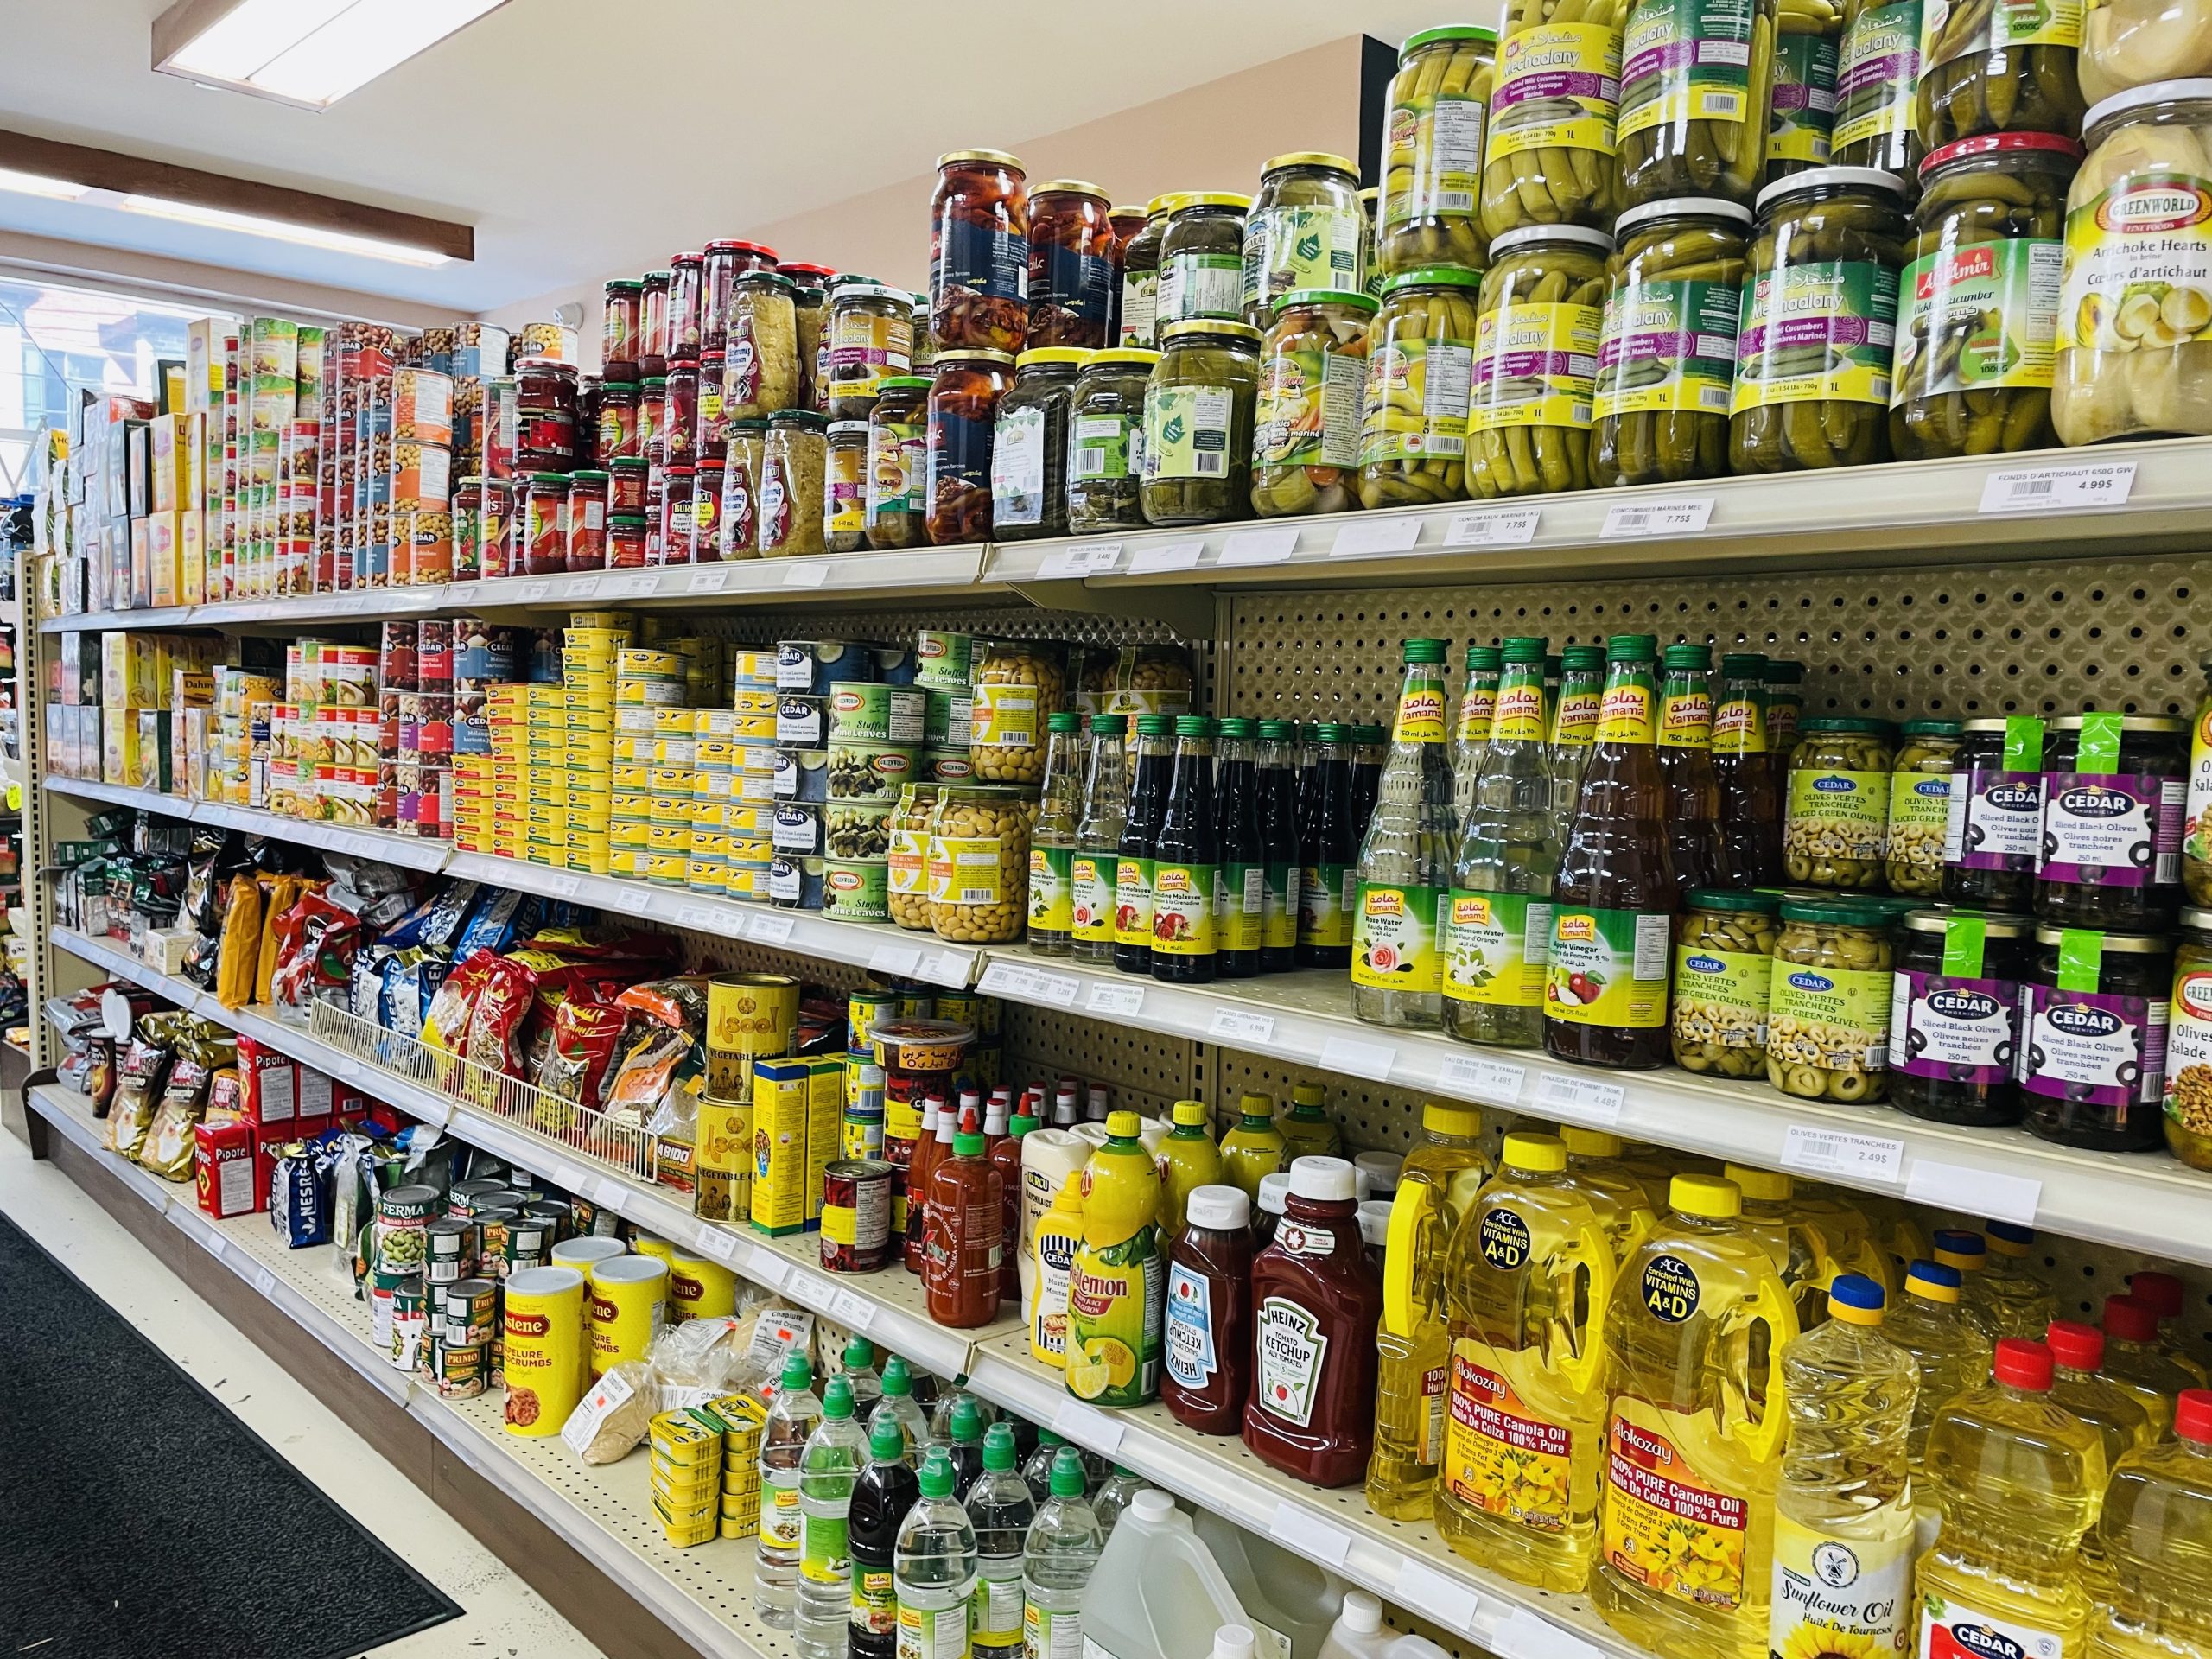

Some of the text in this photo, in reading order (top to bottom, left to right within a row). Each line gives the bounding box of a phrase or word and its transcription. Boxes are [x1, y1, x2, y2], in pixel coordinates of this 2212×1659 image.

[1503, 50, 1580, 78] Mechaalany
[1567, 130, 1574, 139] 1L
[2113, 198, 2196, 213] GREENWORLD
[2161, 240, 2207, 251] Hearts
[2129, 267, 2208, 279] d'artichaut
[1758, 283, 1770, 296] BM
[1785, 323, 1824, 332] Cucumbers
[1797, 332, 1827, 341] Marinés
[1830, 382, 1839, 391] 1L
[1658, 393, 1667, 402] 1L
[1535, 409, 1542, 417] 1L
[2031, 470, 2089, 480] D'ARTICHAUT
[2079, 480, 2113, 490] 4.99$
[1667, 515, 1690, 524] 7.75$
[779, 651, 801, 661] CEDAR
[938, 666, 968, 677] Stuffed
[935, 676, 967, 685] Leaves
[781, 705, 808, 715] CEDAR
[856, 719, 887, 729] Stuffed
[853, 728, 887, 738] Leaves
[1816, 780, 1850, 790] CEDAR
[878, 789, 900, 798] Vine
[1804, 793, 1866, 804] OLIVES VERTES
[2063, 794, 2126, 810] CEDAR
[778, 812, 804, 822] CEDAR
[1818, 810, 1878, 823] GREEN OLIVES
[1980, 813, 2005, 823] Sliced
[2055, 821, 2138, 833] Sliced Black Olives
[2063, 832, 2090, 842] Olives
[855, 899, 886, 908] Stuffed
[850, 908, 886, 917] Leaves
[1365, 916, 1402, 926] Rose Water
[1459, 926, 1482, 935] Blossom
[1569, 944, 1598, 953] Vinegar
[1688, 959, 1720, 970] CEDAR
[1703, 976, 1738, 987] VERTES
[1791, 976, 1827, 989] CEDAR
[1689, 989, 1751, 1008] GREEN OLIVES
[1779, 988, 1846, 1007] OLIVES VERTES
[1933, 995, 1993, 1014] CEDAR
[1792, 1008, 1860, 1029] GREEN OLIVES
[2050, 1011, 2114, 1031] CEDAR
[1922, 1020, 2001, 1033] Sliced Black Olives
[1932, 1032, 1960, 1041] Olives
[2042, 1035, 2125, 1053] Sliced Black Olives
[2050, 1048, 2110, 1062] Olives noires
[1498, 1066, 1522, 1076] YAMAMA
[2065, 1071, 2078, 1079] 250
[1541, 1075, 1569, 1085] VINAIGRE
[1580, 1081, 1601, 1090] POMME
[1790, 1128, 1897, 1150] OLIVES VERTES TRANCHEES
[216, 1148, 245, 1160] Pipore
[1859, 1151, 1887, 1164] 2.49$
[383, 1205, 424, 1218] FERMA
[1484, 1218, 1528, 1238] Enriched With
[1483, 1227, 1528, 1249] VITAMINS
[1648, 1266, 1696, 1287] Enriched With
[1645, 1274, 1696, 1300] VITAMINS
[1271, 1311, 1306, 1334] HEINZ
[1275, 1332, 1298, 1346] TOMATO
[1265, 1335, 1310, 1362] KETCHUP
[447, 1351, 477, 1363] PRIMO
[1268, 1350, 1302, 1369] AUX TOMATES
[1171, 1352, 1198, 1376] HEINZ
[1454, 1358, 1506, 1400] Alokozay
[1452, 1392, 1566, 1441] 100% PURE Canola Oil
[1452, 1404, 1564, 1454] Huile De Colza 100% Pure
[1613, 1421, 1673, 1465] Alokozay
[1477, 1452, 1487, 1461] Fat
[1611, 1454, 1739, 1513] 100% PURE Canola Oil
[1611, 1471, 1738, 1527] Huile De Colza 100% Pure
[1639, 1522, 1651, 1532] Fat
[1781, 1580, 1859, 1618] Sunflower
[1802, 1612, 1846, 1634] Huile De
[1958, 1626, 2018, 1659] CEDAR
